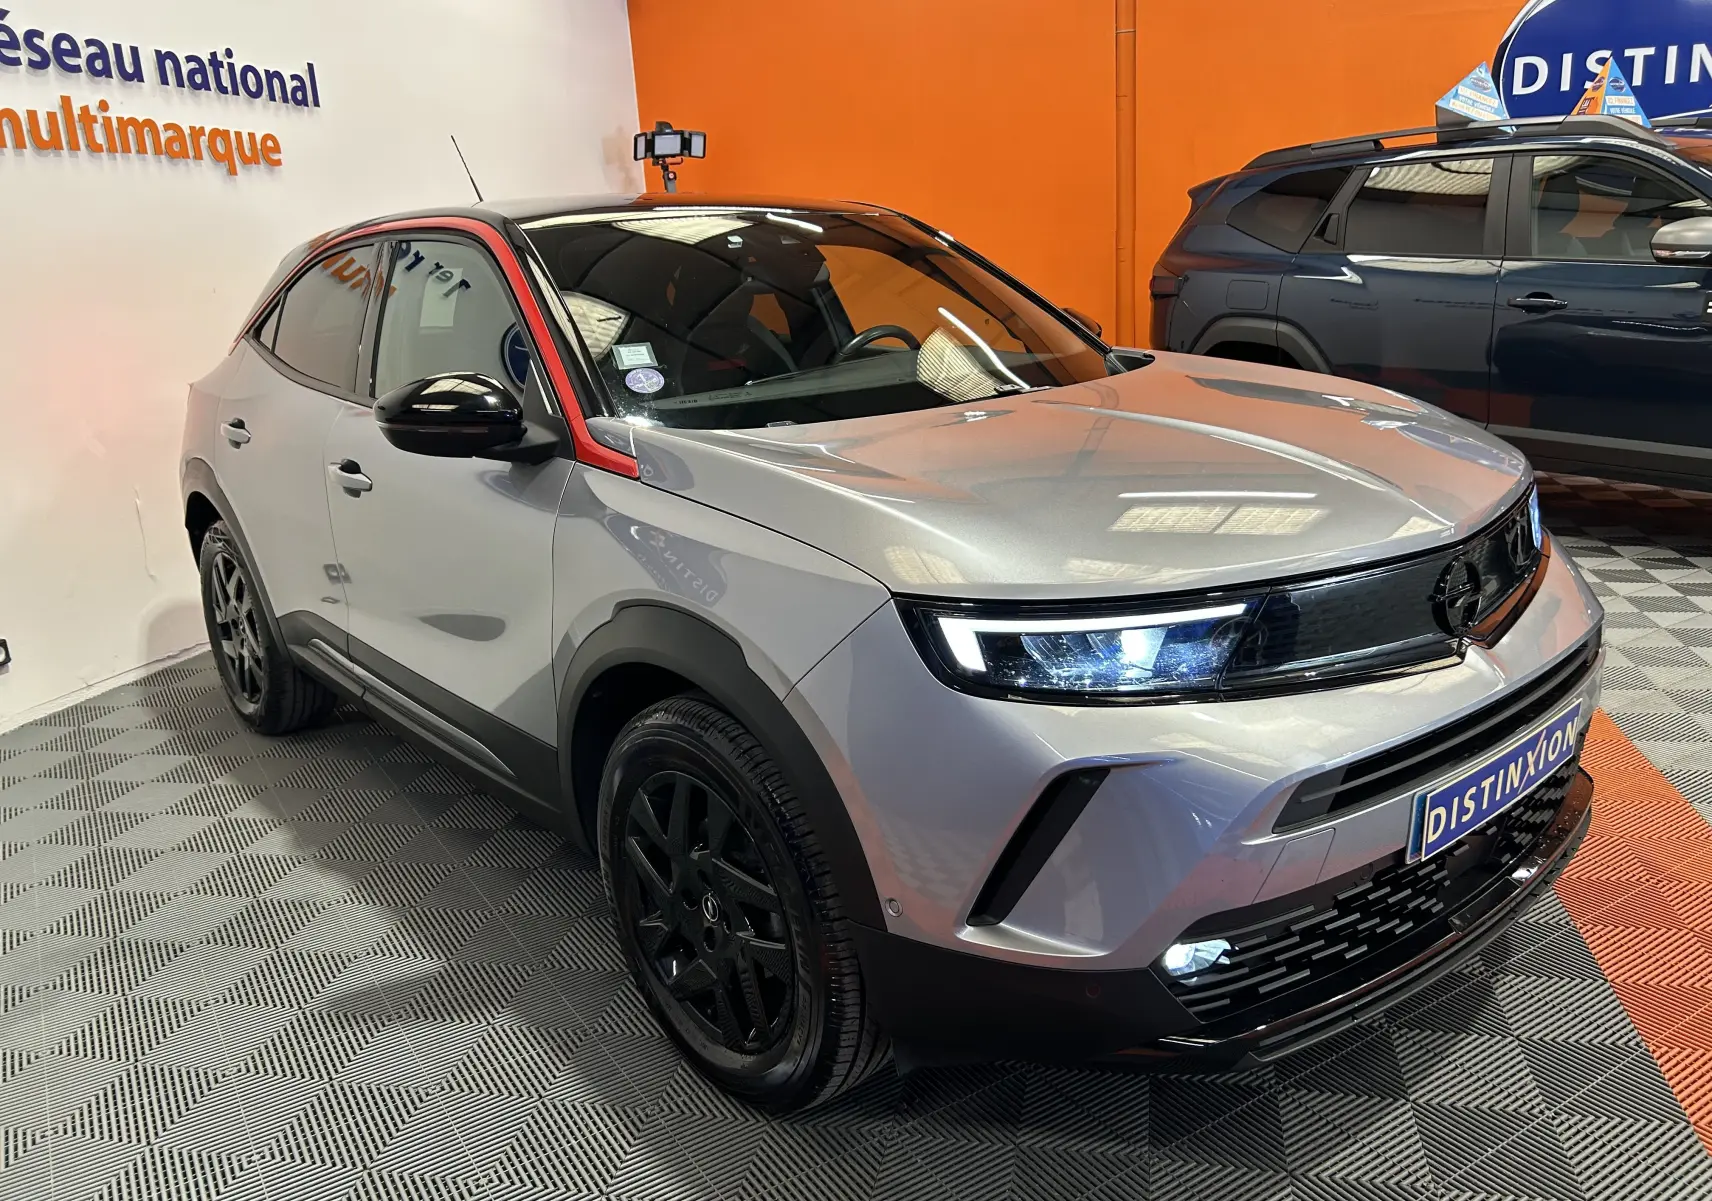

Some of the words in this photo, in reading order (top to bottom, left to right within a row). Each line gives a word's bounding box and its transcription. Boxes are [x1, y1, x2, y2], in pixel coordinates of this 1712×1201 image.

[0, 8, 145, 84] éseau
[154, 47, 321, 108] national
[1427, 716, 1578, 844] DISTINXION
